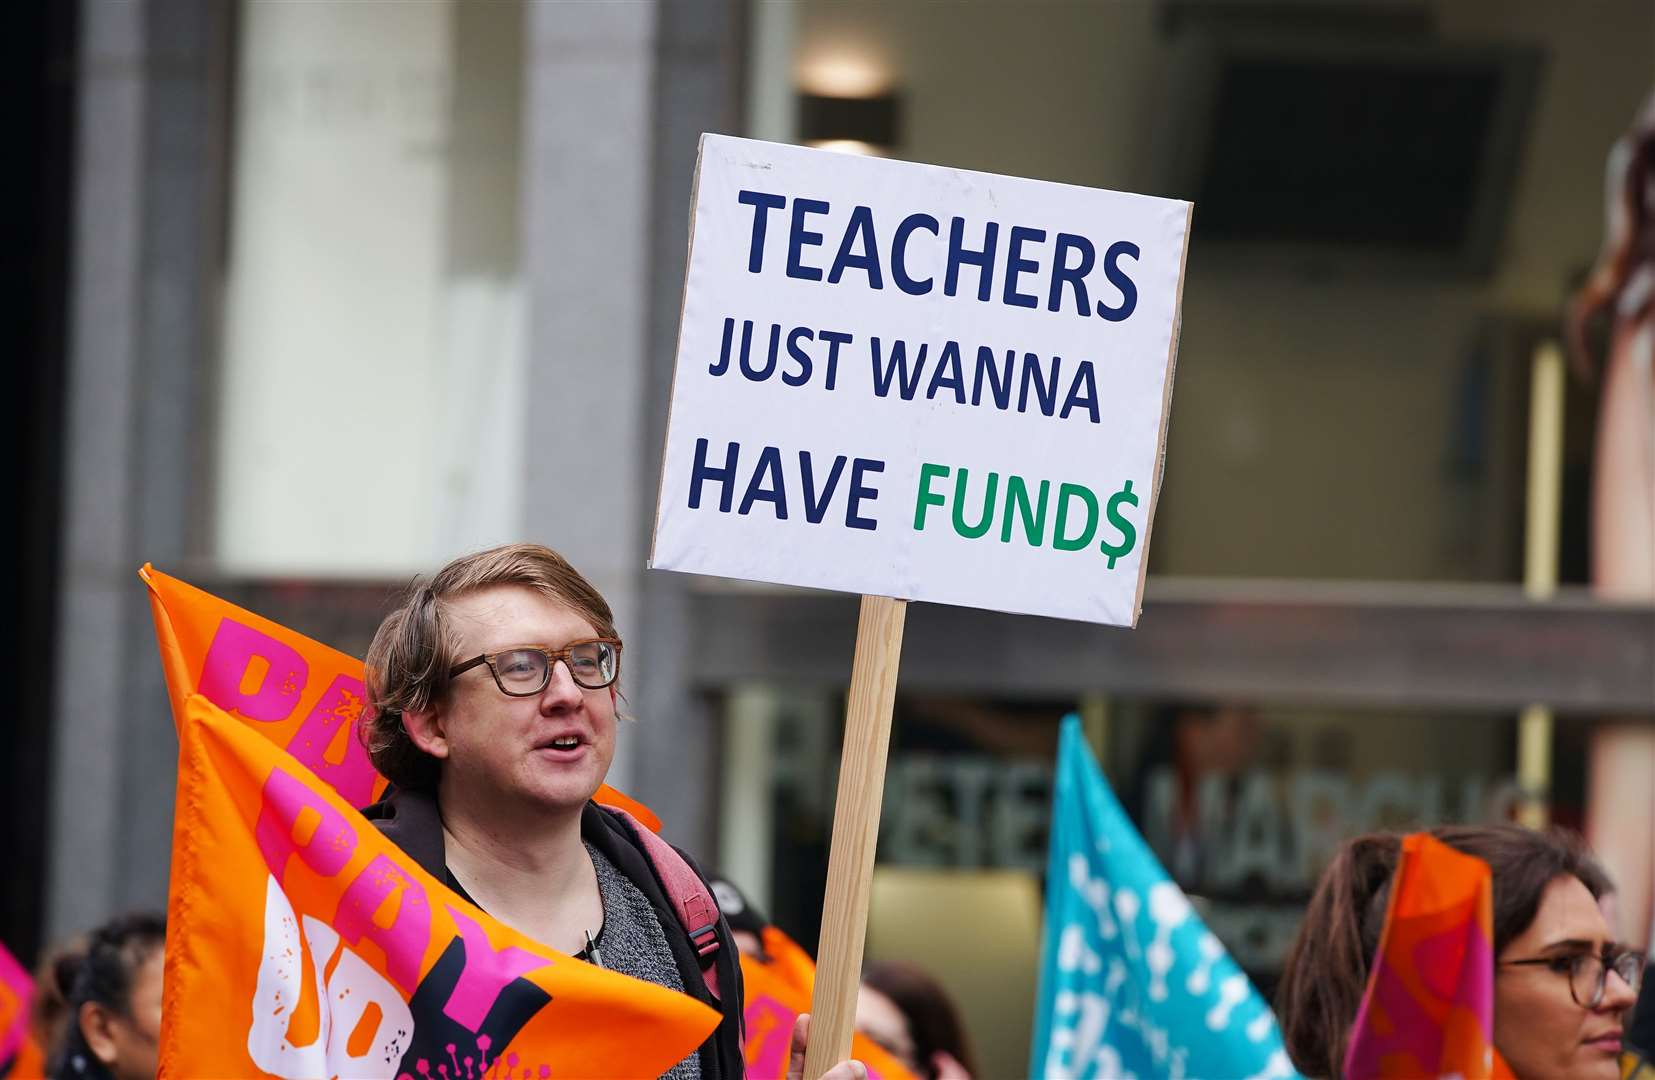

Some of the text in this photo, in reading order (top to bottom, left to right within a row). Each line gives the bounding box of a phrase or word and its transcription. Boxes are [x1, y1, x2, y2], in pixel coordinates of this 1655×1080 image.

[738, 189, 1141, 323] TEACHERS
[708, 317, 1101, 424] JUST WANNA
[687, 437, 1139, 570] HAVE FUND$
[255, 766, 556, 1035] PAY
[247, 873, 416, 1080] UP
